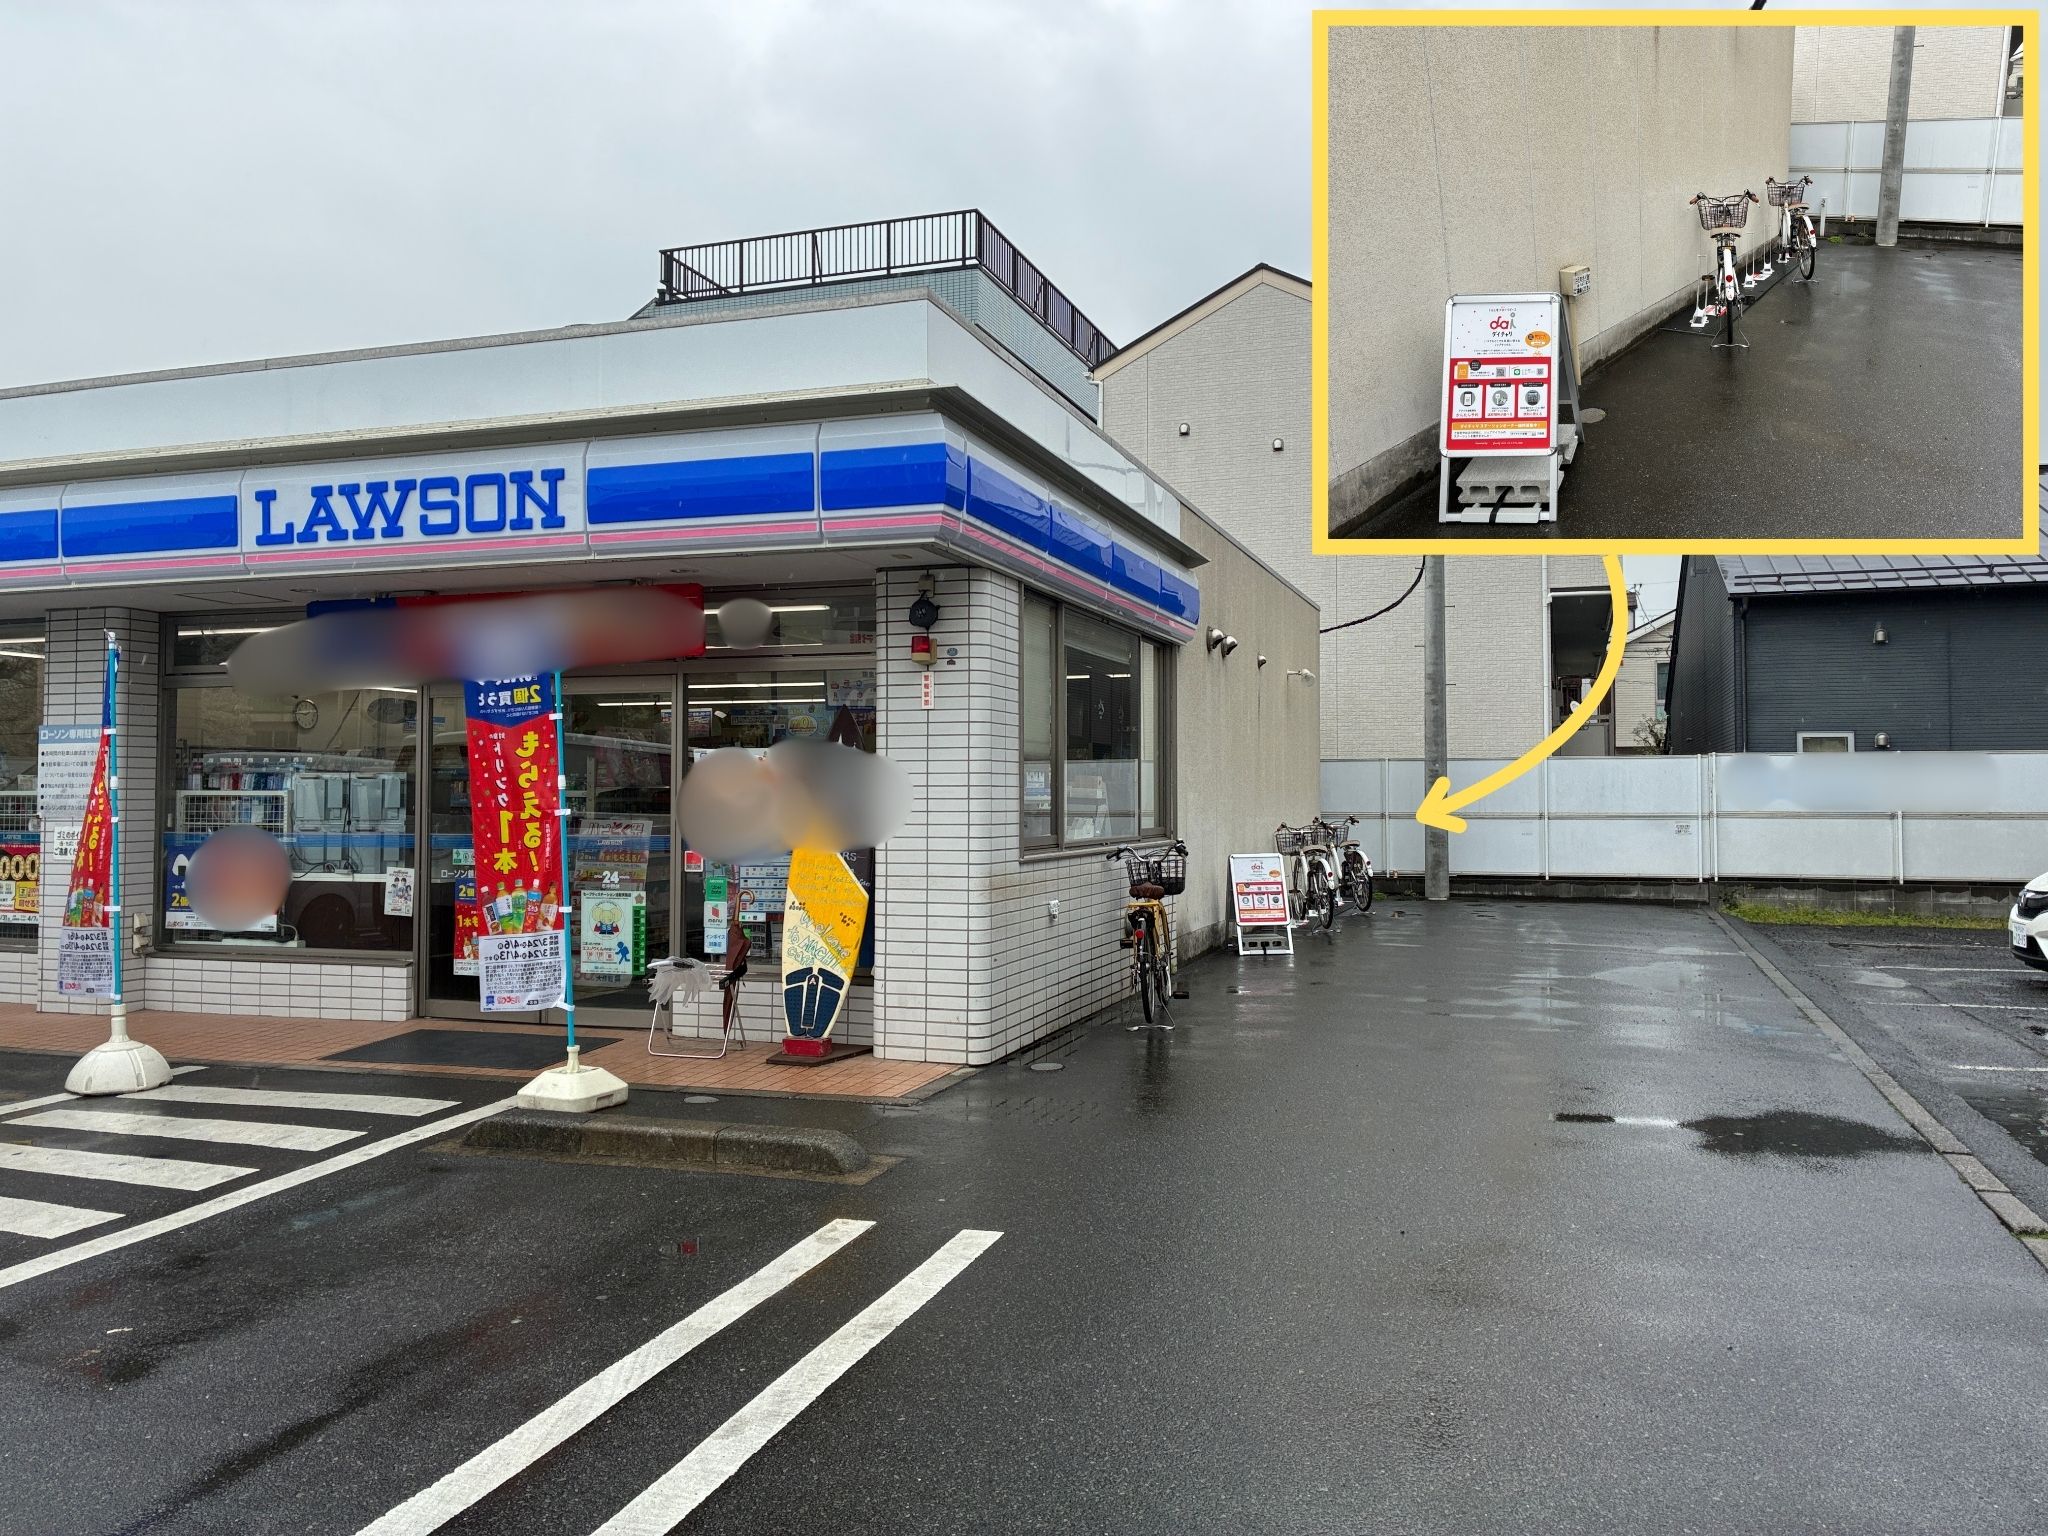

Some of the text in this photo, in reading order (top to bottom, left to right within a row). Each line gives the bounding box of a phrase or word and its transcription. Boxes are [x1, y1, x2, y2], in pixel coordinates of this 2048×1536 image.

[255, 468, 566, 546] LAWSON
[41, 729, 100, 740] ローソン専用駐車
[602, 870, 620, 884] 24
